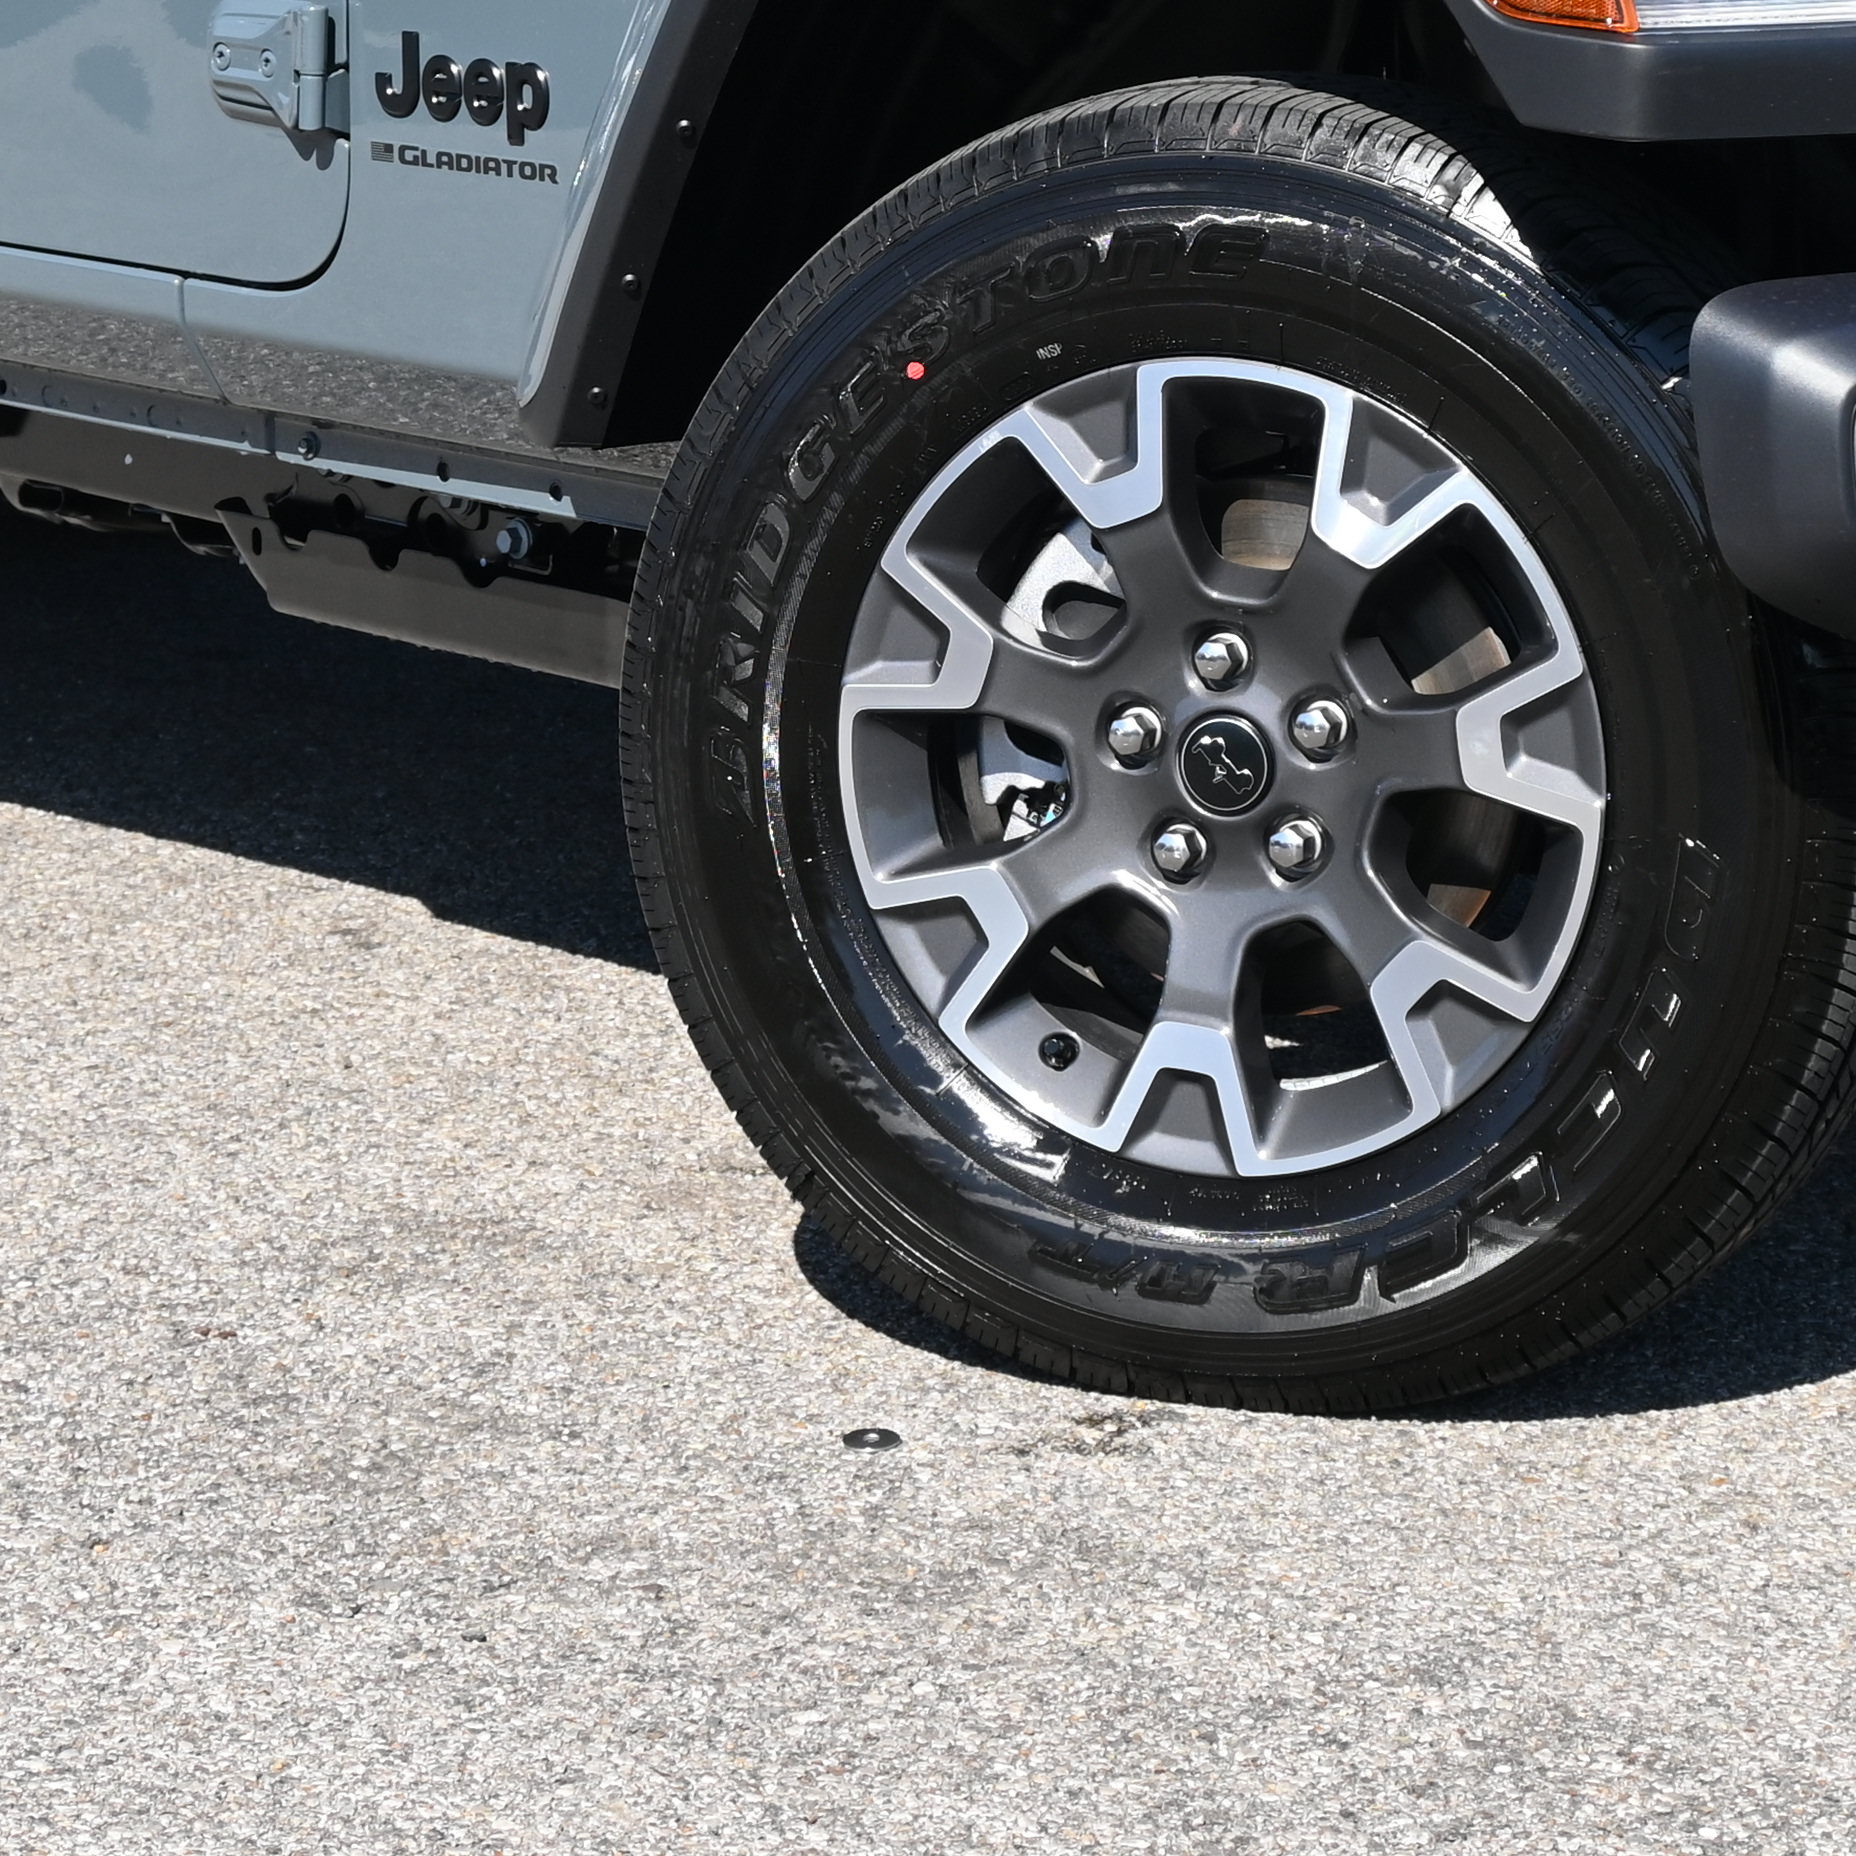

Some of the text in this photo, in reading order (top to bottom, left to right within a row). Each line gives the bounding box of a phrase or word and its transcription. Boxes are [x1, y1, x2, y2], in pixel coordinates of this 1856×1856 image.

[374, 30, 551, 147] Jeep
[397, 144, 559, 185] GLADIATOR
[708, 222, 1272, 828] BRIDGESTONE
